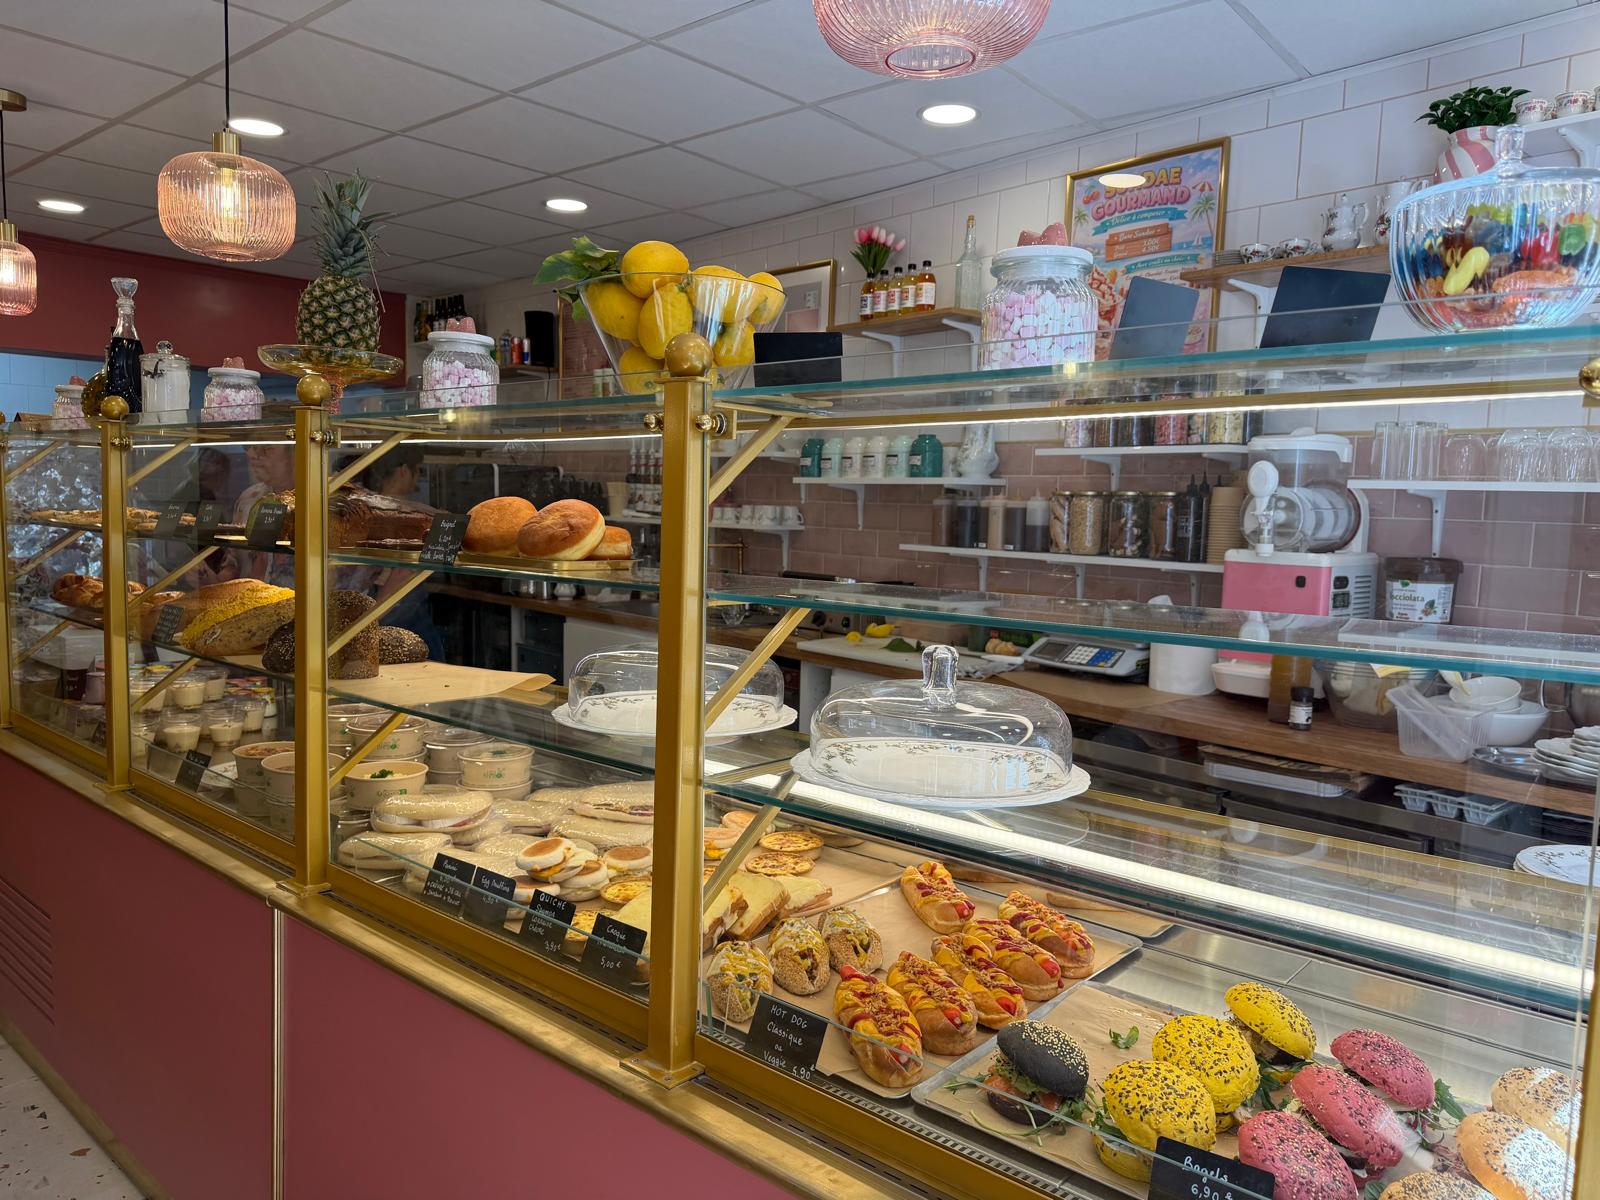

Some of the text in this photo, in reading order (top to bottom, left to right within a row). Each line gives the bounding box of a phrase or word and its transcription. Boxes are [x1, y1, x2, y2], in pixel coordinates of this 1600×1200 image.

[1104, 167, 1182, 199] SDAE
[1092, 186, 1191, 220] GOURMAND
[481, 875, 490, 888] Egg
[540, 892, 567, 911] QUICHE
[606, 924, 627, 943] Croque
[770, 1004, 808, 1029] HOT DOG
[766, 1021, 804, 1046] Classique
[774, 1043, 783, 1052] ou
[763, 1050, 787, 1068] Veggie
[1181, 1155, 1229, 1184] Bagels
